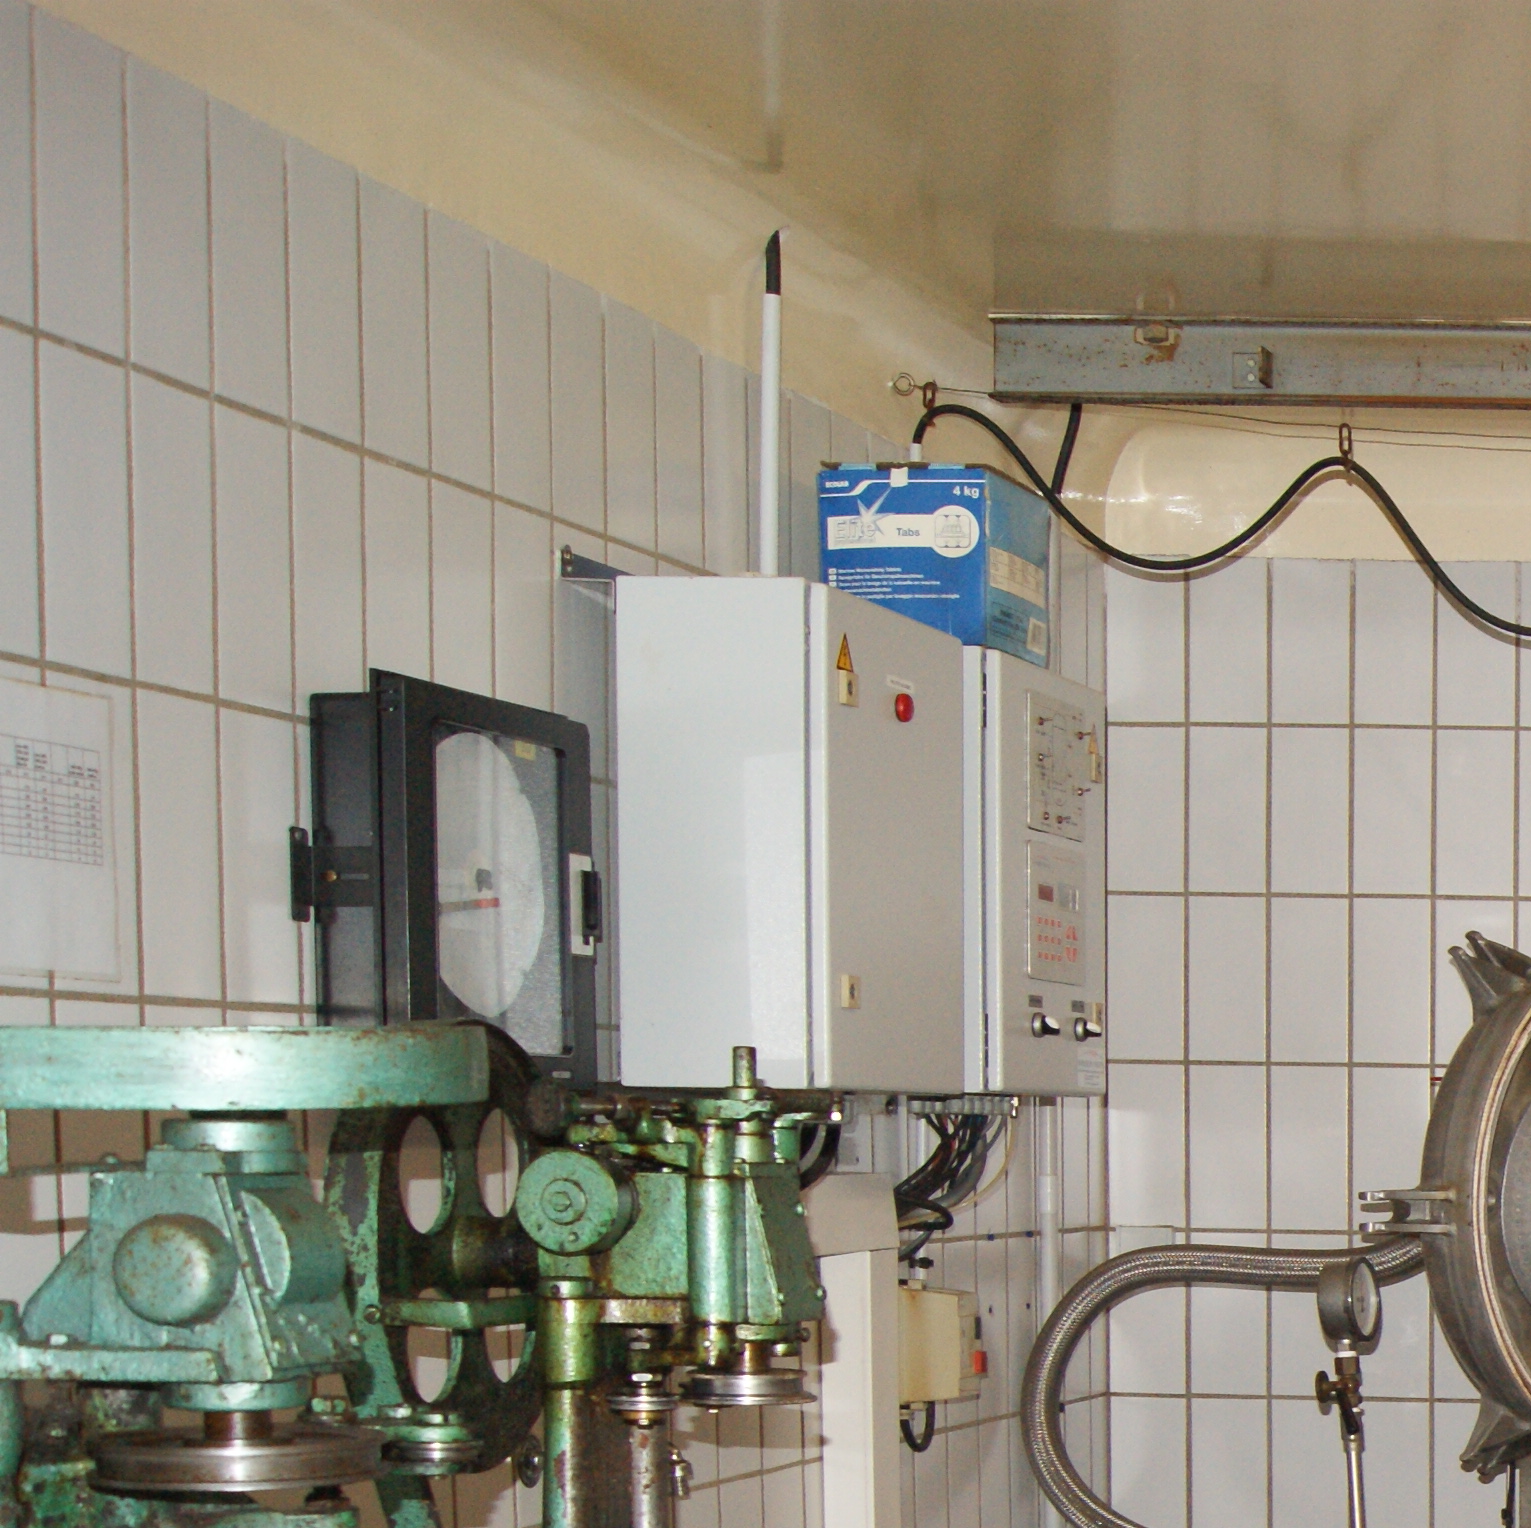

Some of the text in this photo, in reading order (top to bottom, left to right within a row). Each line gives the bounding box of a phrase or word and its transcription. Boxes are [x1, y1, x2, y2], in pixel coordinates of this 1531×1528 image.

[952, 485, 980, 498] 4 kg
[896, 527, 921, 537] Tabs
